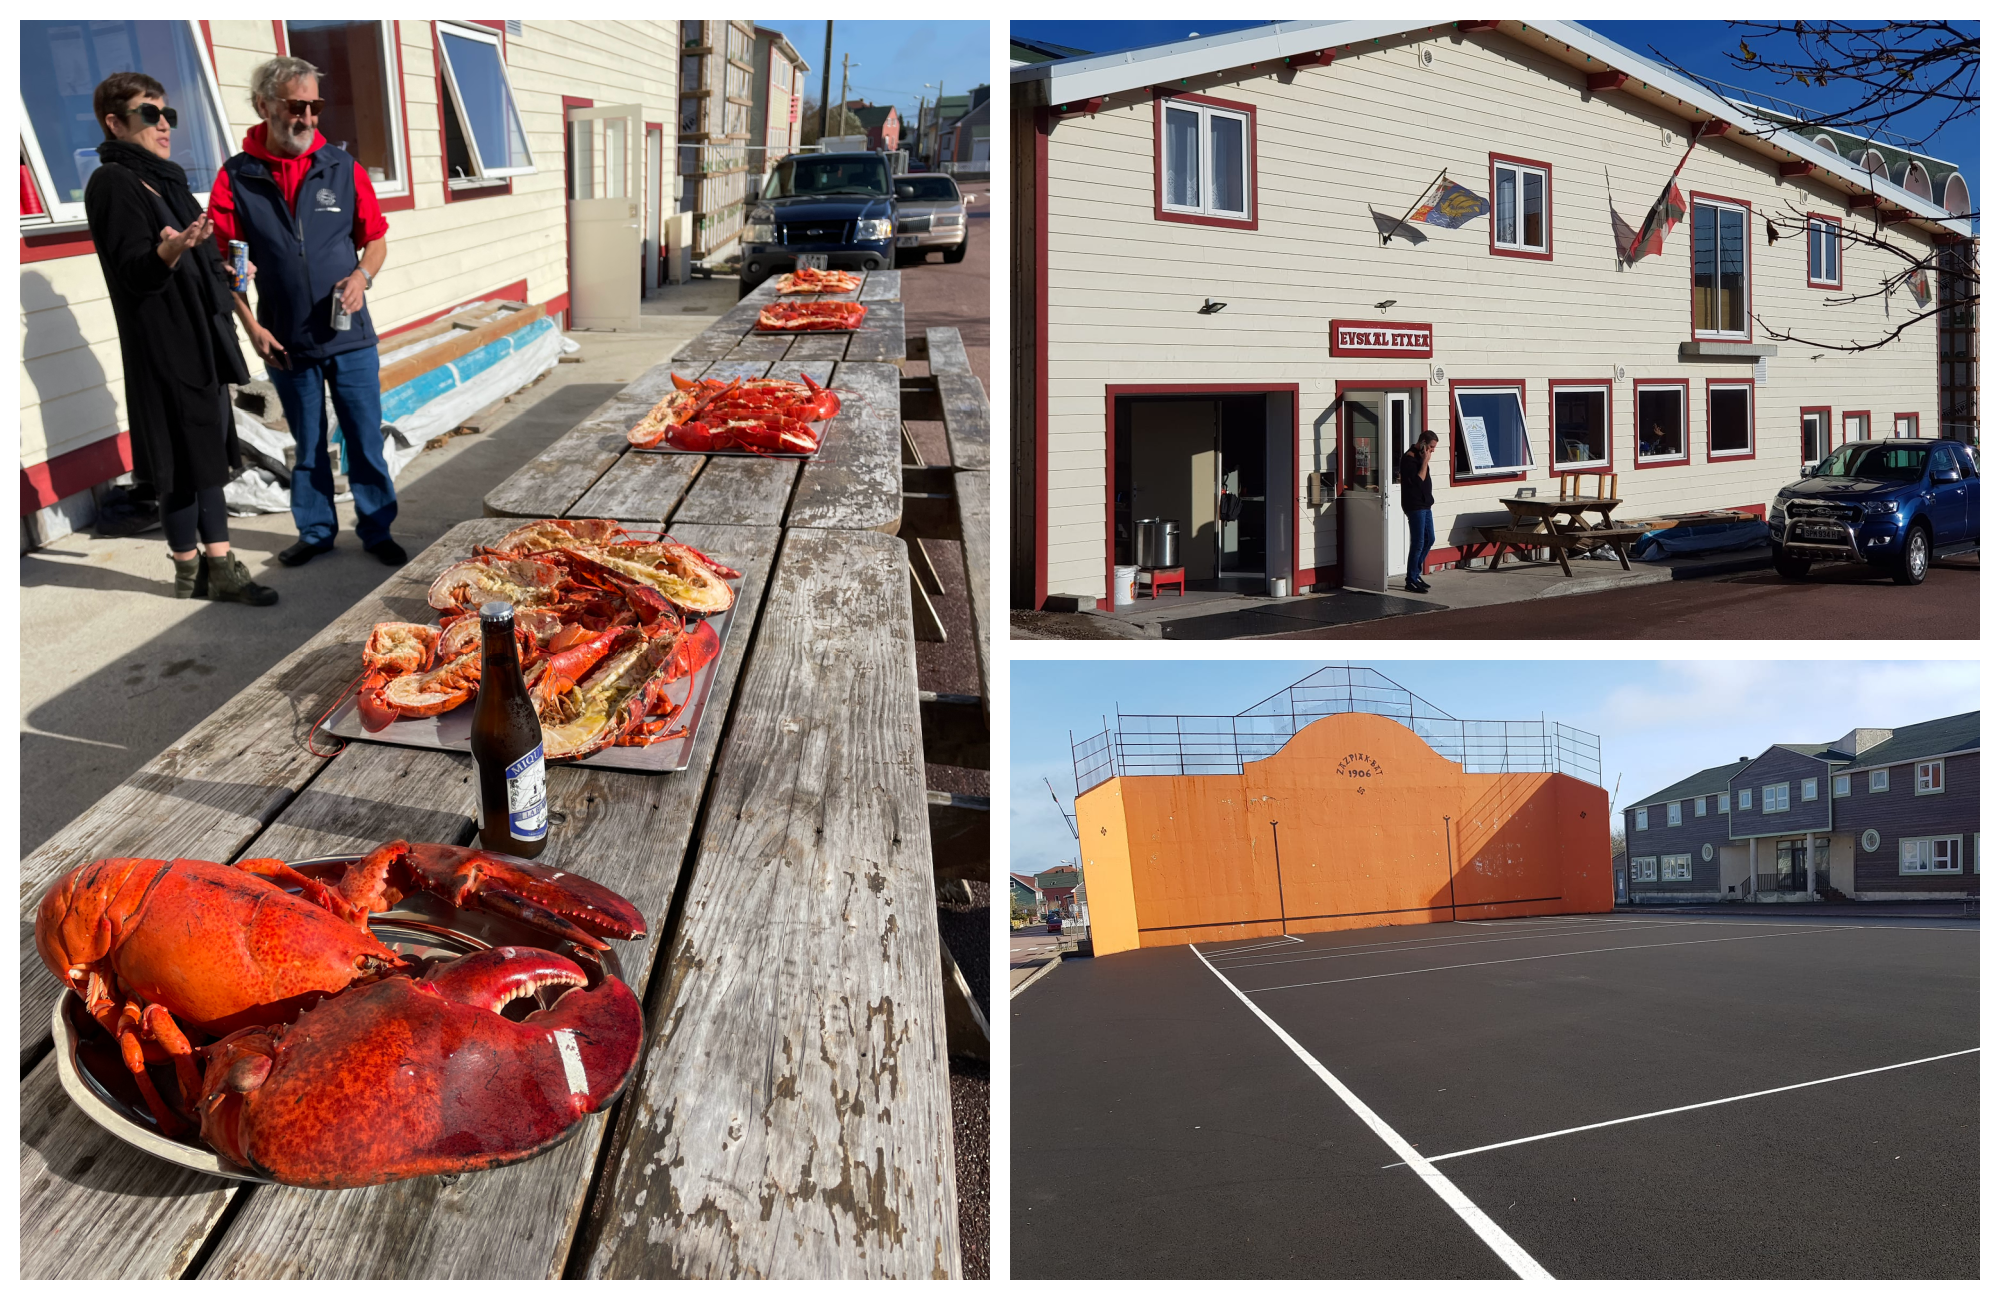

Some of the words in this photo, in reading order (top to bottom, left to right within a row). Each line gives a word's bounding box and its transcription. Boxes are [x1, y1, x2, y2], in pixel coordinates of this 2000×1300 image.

[1391, 333, 1430, 348] ETXEA
[511, 746, 544, 776] MIQU
[1336, 752, 1384, 776] ZAZPIAK-BAT
[1348, 769, 1372, 778] 1906
